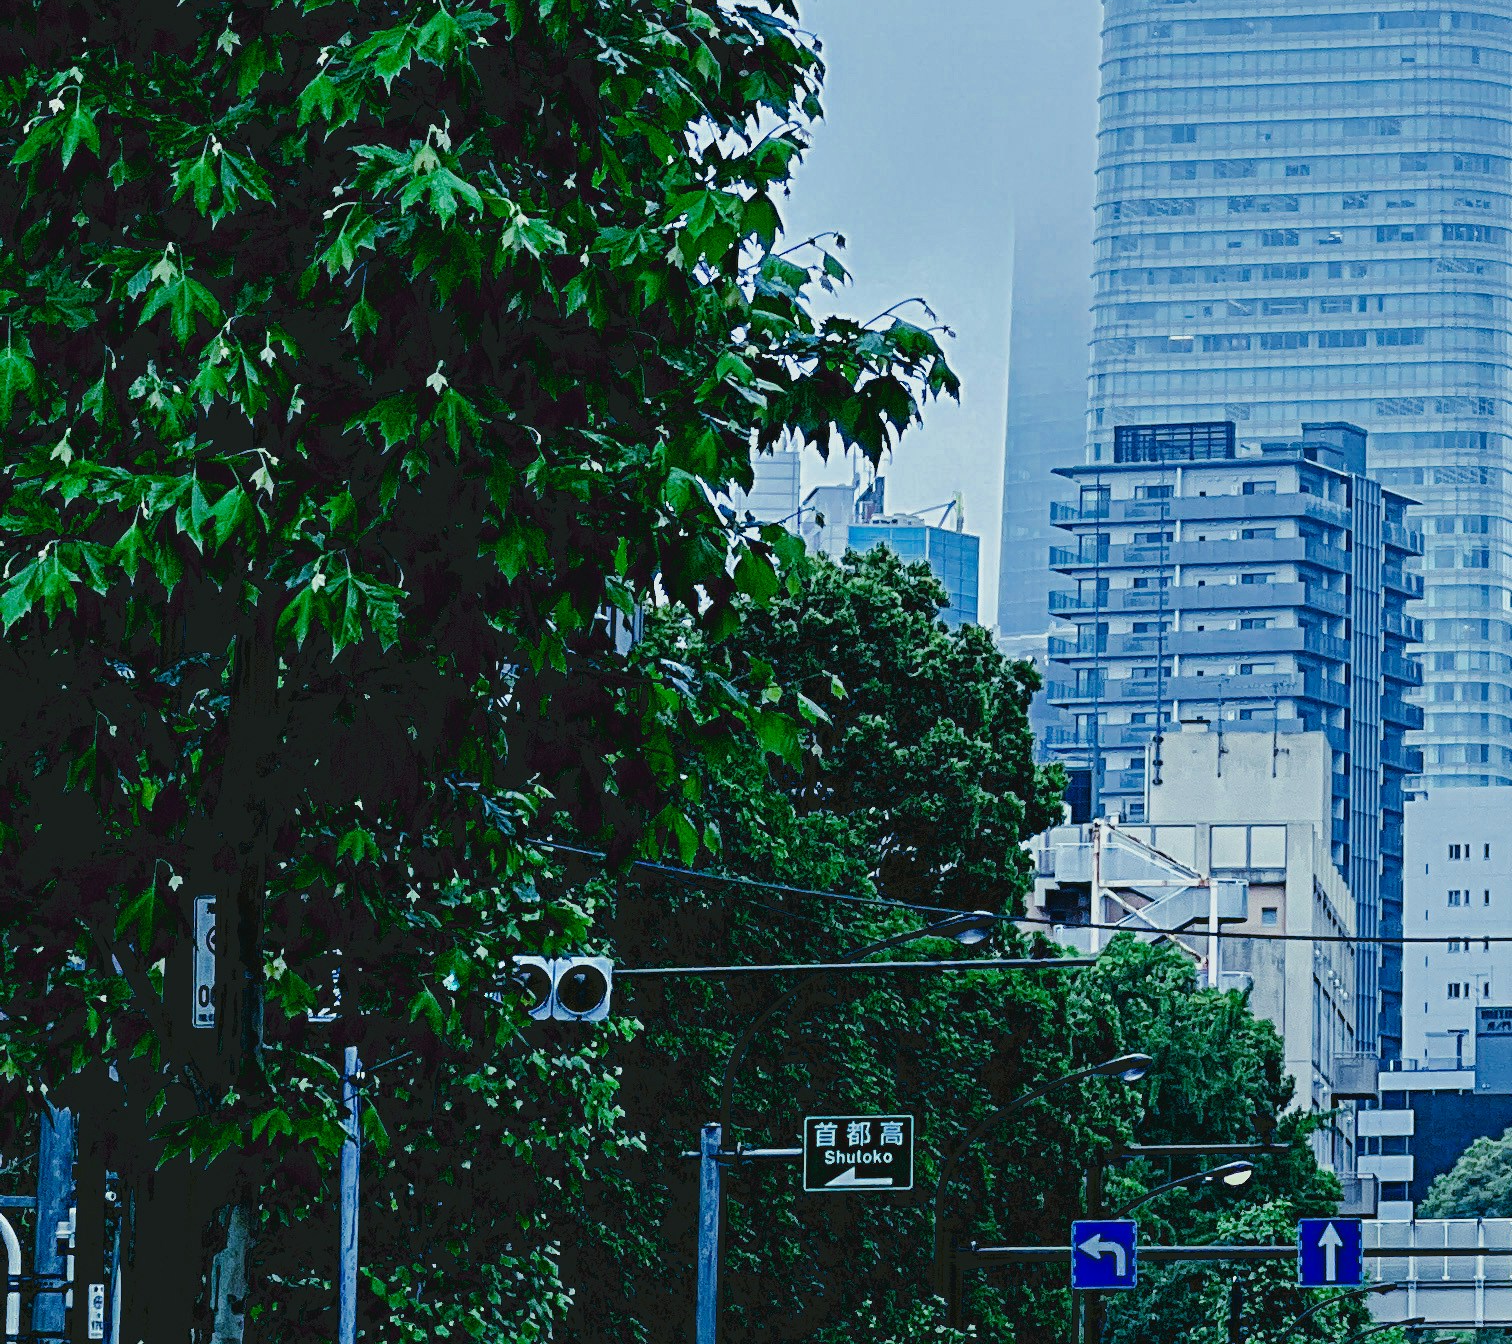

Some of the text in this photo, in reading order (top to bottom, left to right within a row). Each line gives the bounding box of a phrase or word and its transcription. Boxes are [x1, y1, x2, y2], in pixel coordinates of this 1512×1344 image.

[814, 1120, 904, 1148] 首都高
[824, 1149, 894, 1165] Shutoko
